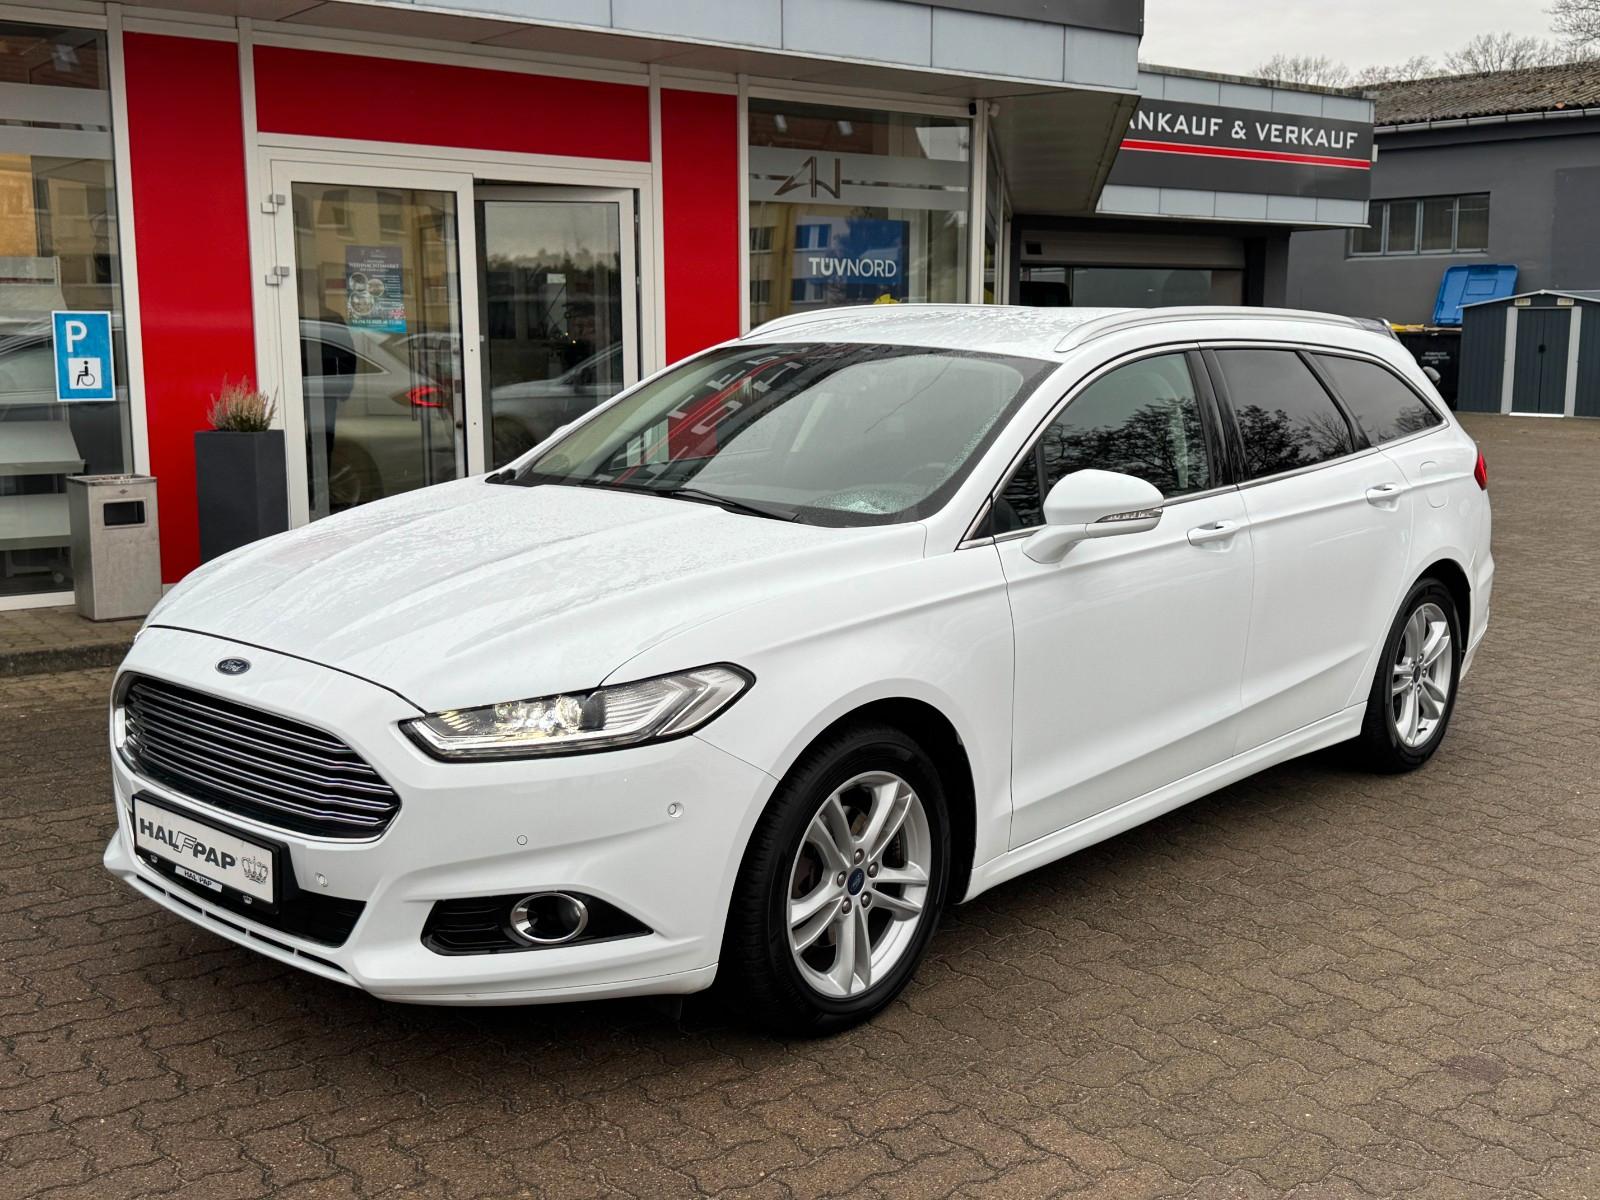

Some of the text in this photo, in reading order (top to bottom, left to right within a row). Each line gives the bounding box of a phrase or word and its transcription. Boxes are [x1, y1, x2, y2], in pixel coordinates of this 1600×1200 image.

[1231, 120, 1247, 140] &
[1256, 122, 1359, 150] VERKAUF
[65, 320, 88, 353] P
